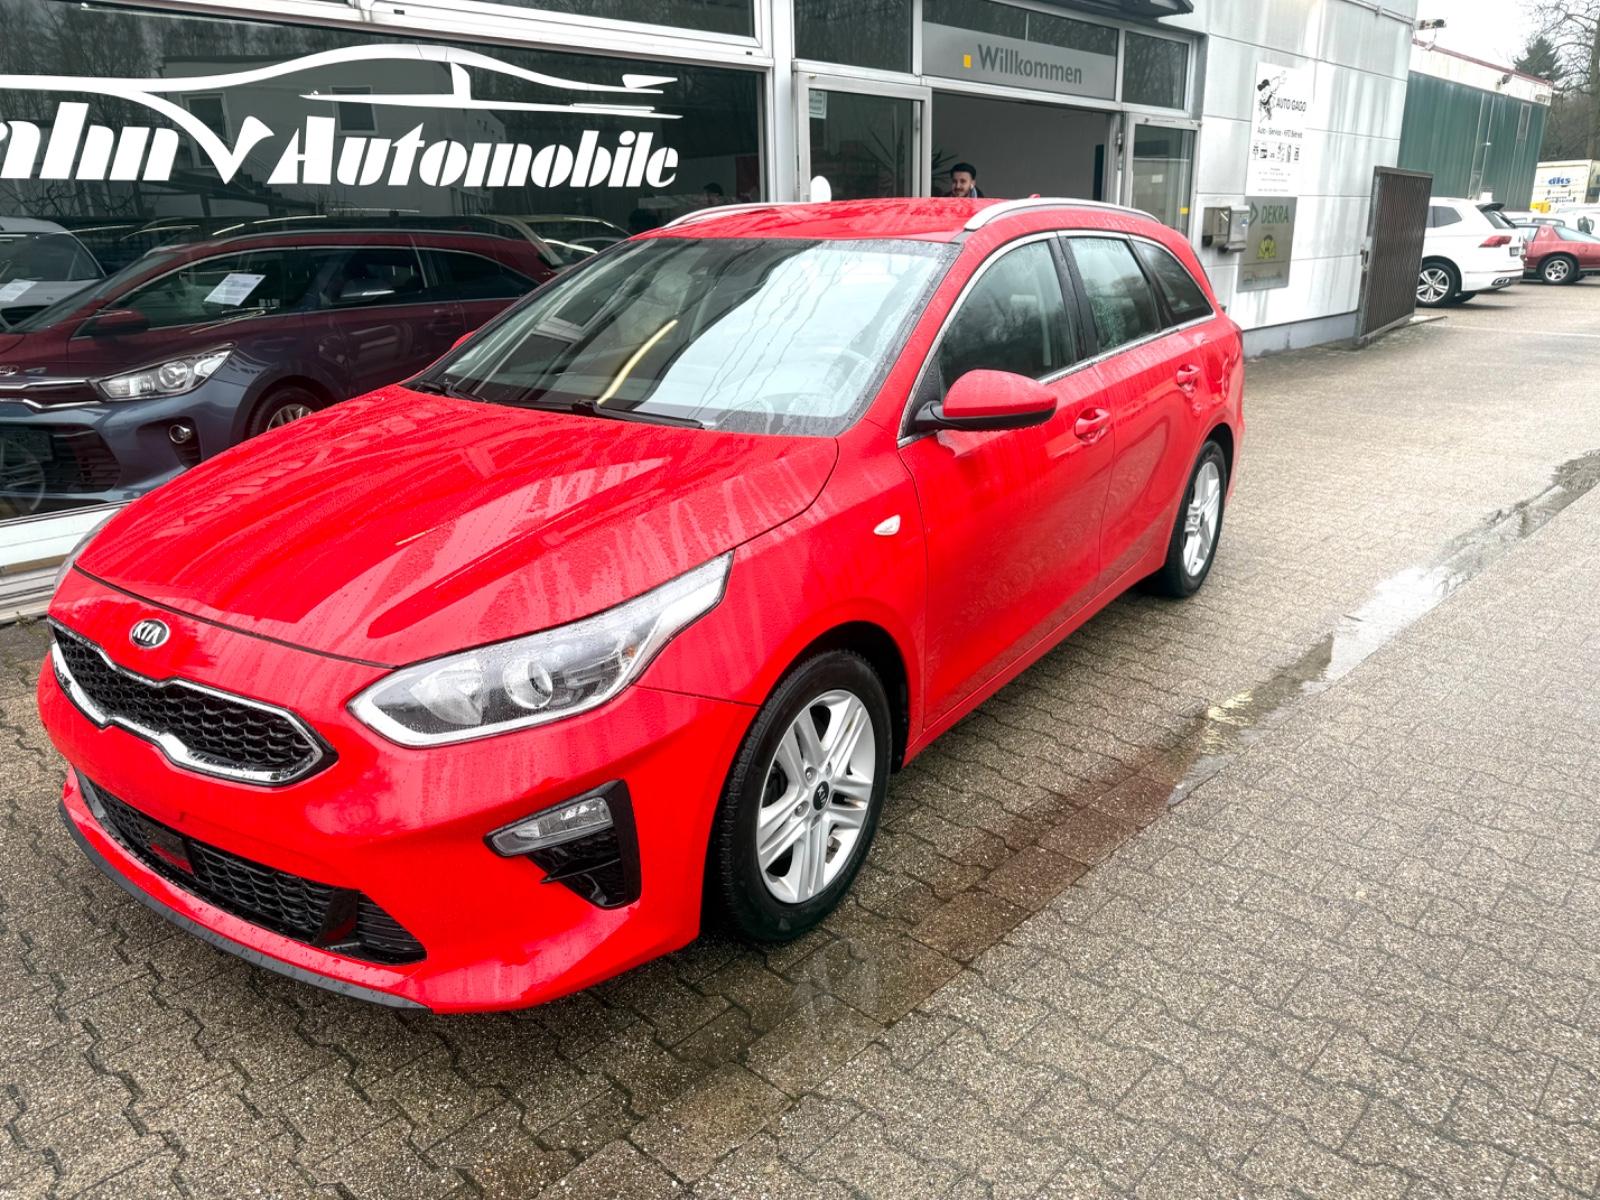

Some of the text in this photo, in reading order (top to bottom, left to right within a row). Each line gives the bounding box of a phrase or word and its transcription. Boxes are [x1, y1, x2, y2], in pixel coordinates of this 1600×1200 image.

[977, 43, 1082, 85] Willkommen
[1276, 97, 1290, 110] AUTO
[267, 115, 680, 188] Automobile
[1261, 204, 1289, 225] DEKRA
[132, 621, 162, 645] KIA
